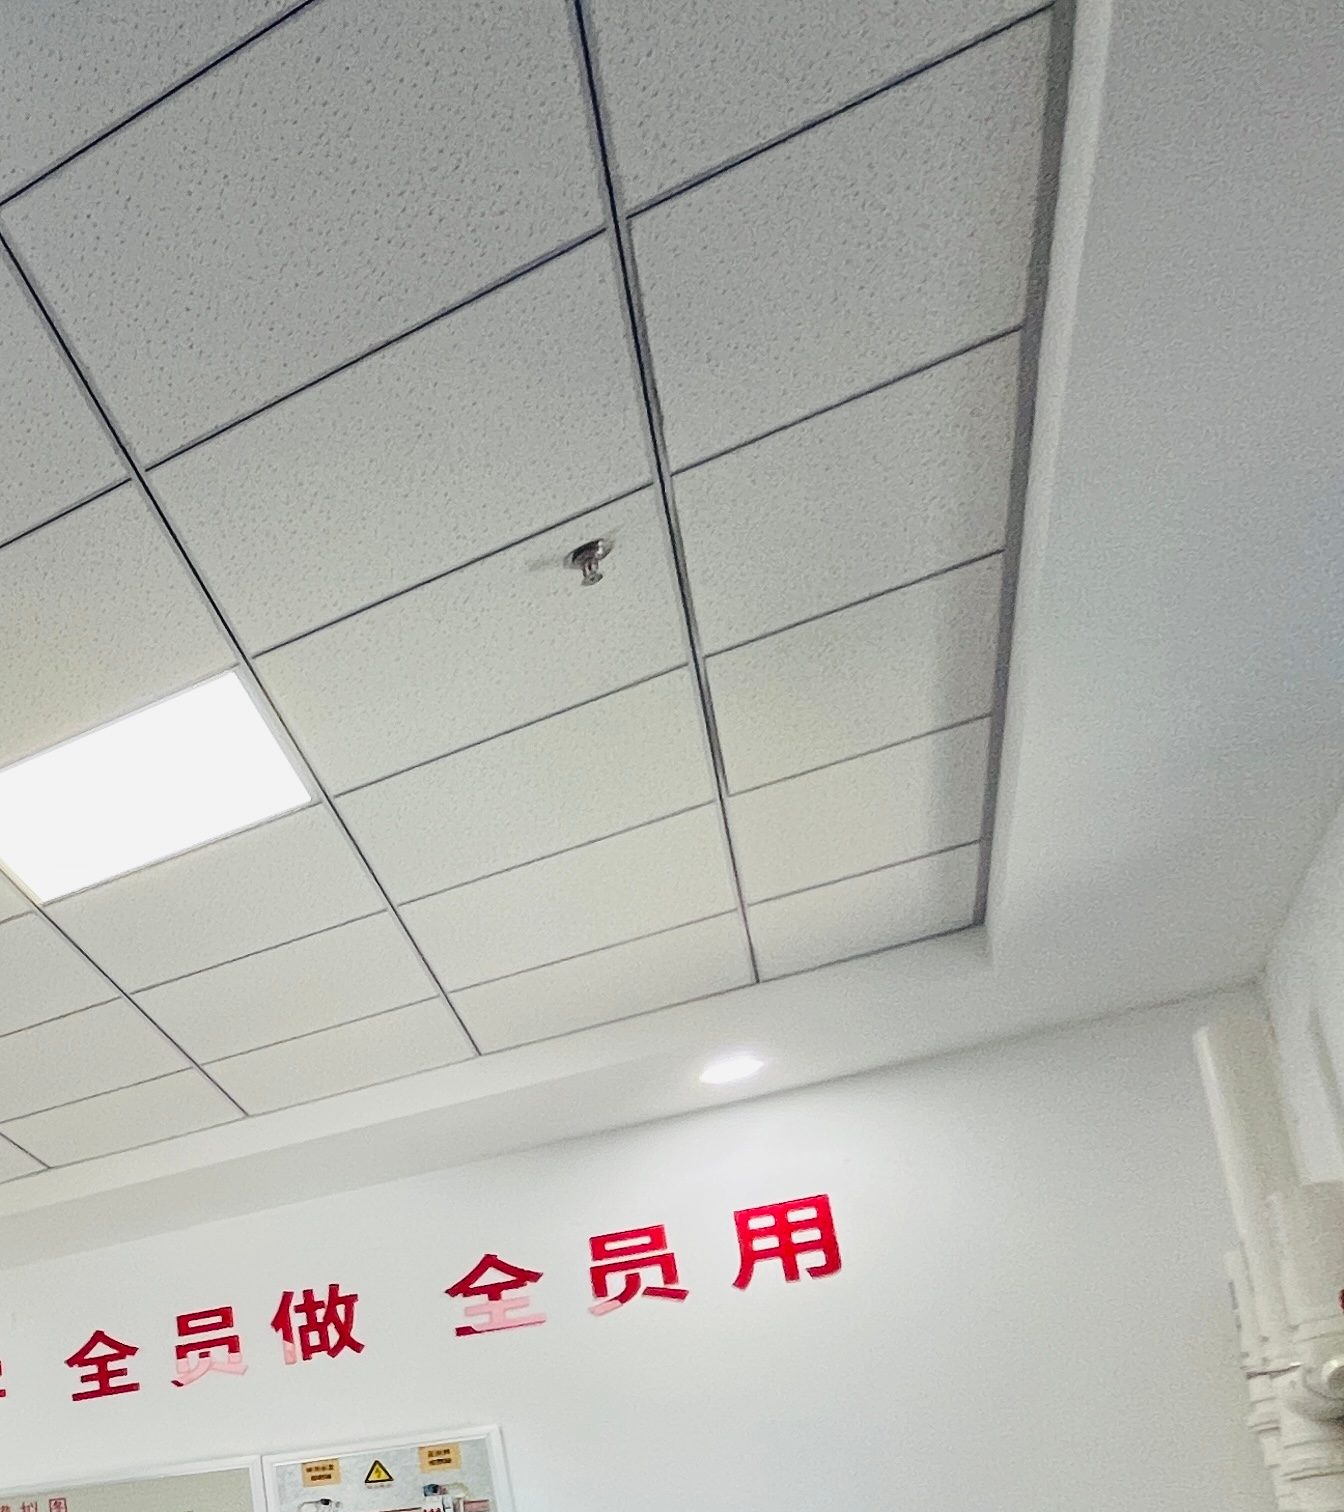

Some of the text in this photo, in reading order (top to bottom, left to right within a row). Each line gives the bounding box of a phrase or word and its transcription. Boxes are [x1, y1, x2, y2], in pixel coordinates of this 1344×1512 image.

[65, 1283, 365, 1402] 全员做
[446, 1192, 844, 1338] 全员用
